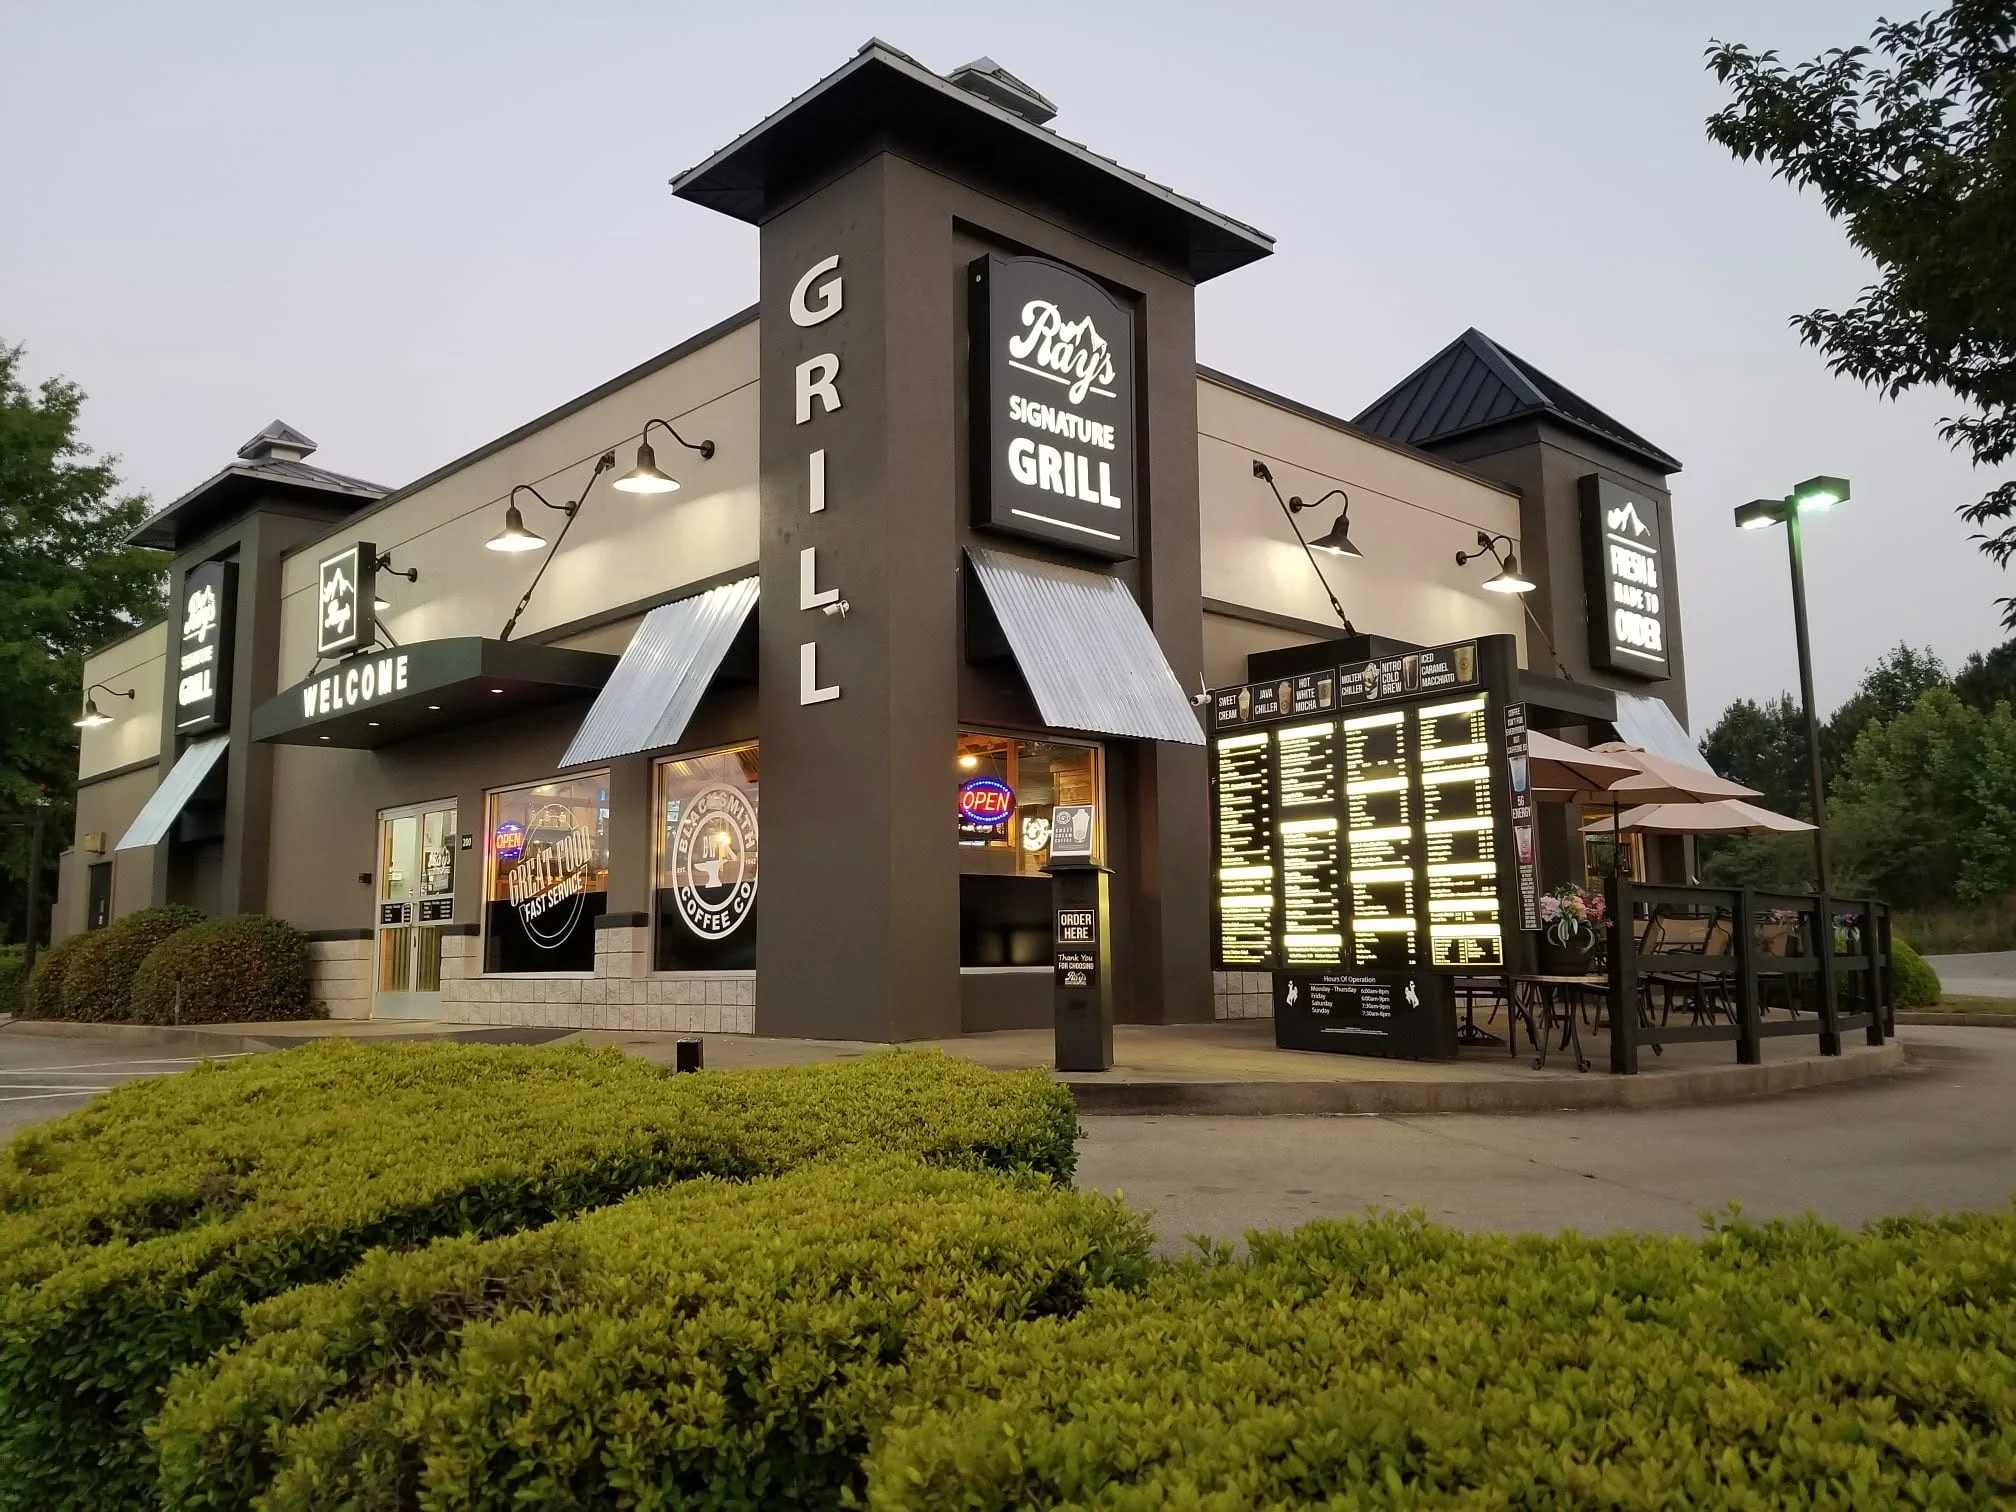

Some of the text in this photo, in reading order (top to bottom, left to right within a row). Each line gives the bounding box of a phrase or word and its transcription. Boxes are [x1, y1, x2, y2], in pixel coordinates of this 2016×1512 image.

[1009, 300, 1116, 404] Ray's
[1009, 395, 1115, 450] SIGNATURE
[1008, 437, 1121, 509] GRILL
[789, 254, 843, 706] GRILL
[1646, 591, 1660, 614] TO
[1614, 608, 1662, 651] ORDER
[1420, 653, 1434, 663] ICED
[1381, 660, 1402, 673] NITRO
[1421, 662, 1449, 675] CARAMEL
[1298, 677, 1311, 688] HOT
[1341, 672, 1362, 685] MOLTEN
[1382, 671, 1400, 684] COLD
[1421, 673, 1455, 687] MACCHIATO
[303, 655, 408, 718] WELCOME
[1341, 684, 1363, 696] CHILLER
[1382, 682, 1402, 695] BREW
[1218, 694, 1237, 707] SWEET
[1259, 688, 1273, 700] JAVA
[1296, 688, 1315, 701] WHITE
[1254, 702, 1278, 715] CHILLER
[1295, 700, 1317, 712] MOCHA
[1218, 709, 1237, 721] CREAM
[962, 791, 1011, 811] OPEN
[1512, 807, 1531, 819] ENERGY
[462, 838, 472, 846] 200
[496, 832, 521, 848] OPEN
[508, 825, 592, 907] GREAT FOOD
[525, 870, 583, 922] FAST SERVICE
[681, 882, 751, 931] COFFEE CO
[1061, 914, 1092, 925] ORDER
[1064, 927, 1088, 939] HERE
[1058, 962, 1094, 970] FOR CHOOSING
[1348, 976, 1376, 984] Operation
[1334, 986, 1357, 994] Thursday
[1311, 1000, 1333, 1008] Saturday
[1311, 1007, 1330, 1015] Sunday
